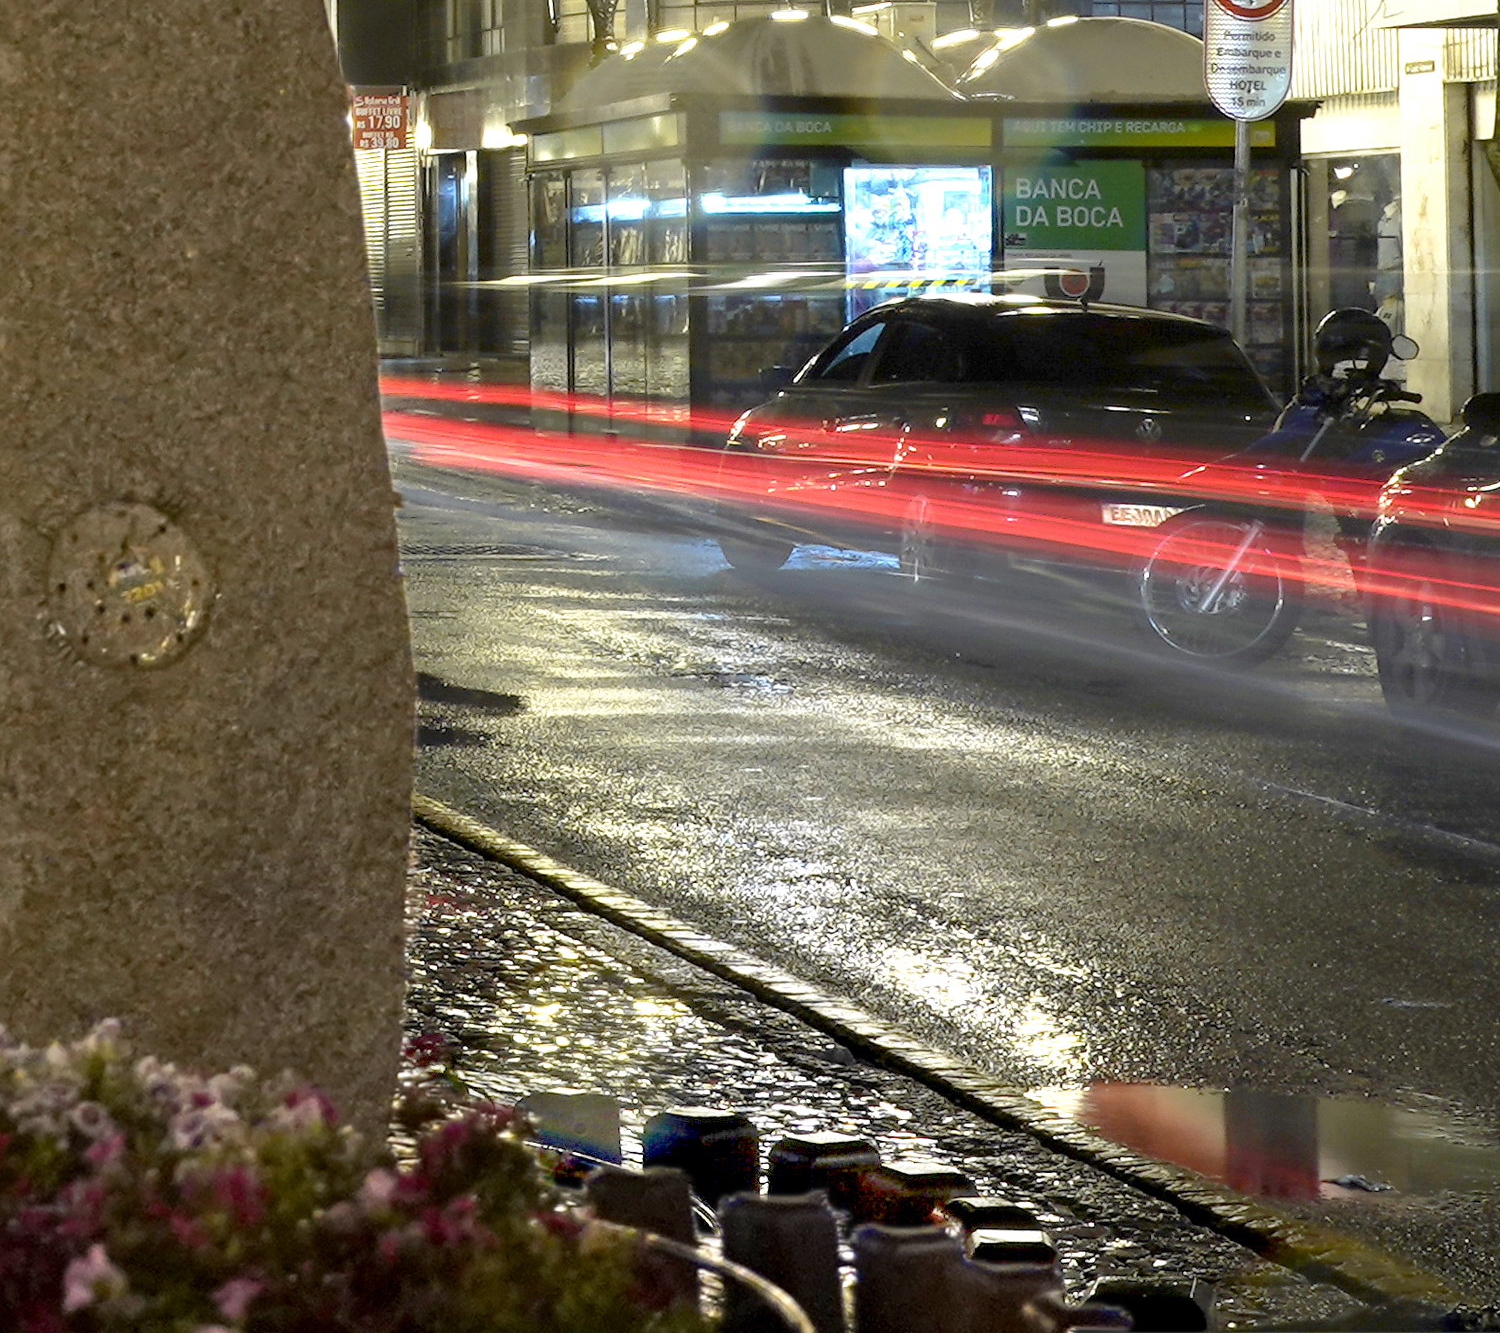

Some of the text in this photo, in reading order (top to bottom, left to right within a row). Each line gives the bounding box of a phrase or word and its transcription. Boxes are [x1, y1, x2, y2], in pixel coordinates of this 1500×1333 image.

[1216, 47, 1272, 59] Embarque
[1229, 80, 1267, 91] HOTEL
[1246, 97, 1266, 107] min
[368, 115, 401, 130] 17,90
[775, 122, 794, 133] DA
[796, 122, 832, 134] BOCA
[1051, 121, 1075, 133] TEM
[1080, 121, 1113, 134] CHIP
[1115, 121, 1123, 133] E
[1126, 121, 1186, 134] RECARGA
[1015, 178, 1101, 200] BANCA
[1015, 205, 1124, 229] DA BOCA
